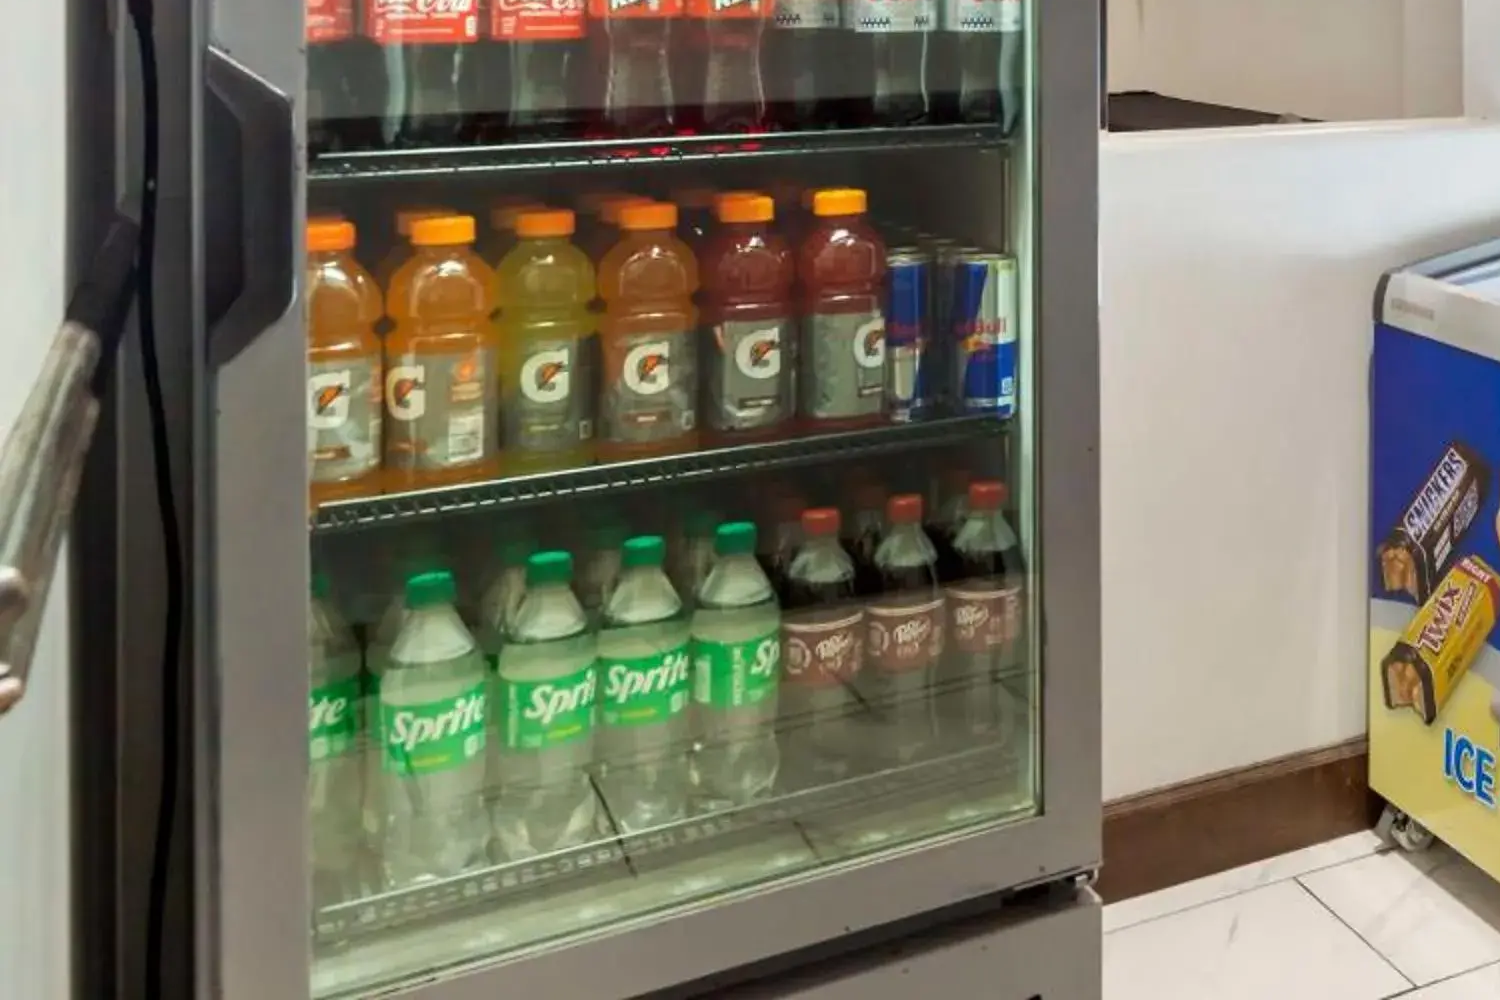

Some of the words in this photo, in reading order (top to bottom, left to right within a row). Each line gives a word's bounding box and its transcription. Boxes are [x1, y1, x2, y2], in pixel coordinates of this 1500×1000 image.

[520, 348, 569, 403] G
[624, 341, 669, 395] G
[736, 327, 781, 379] G
[386, 364, 425, 421] G
[1406, 449, 1464, 541] SNICKERS
[524, 668, 596, 725] Spri
[1442, 728, 1497, 808] ICE
